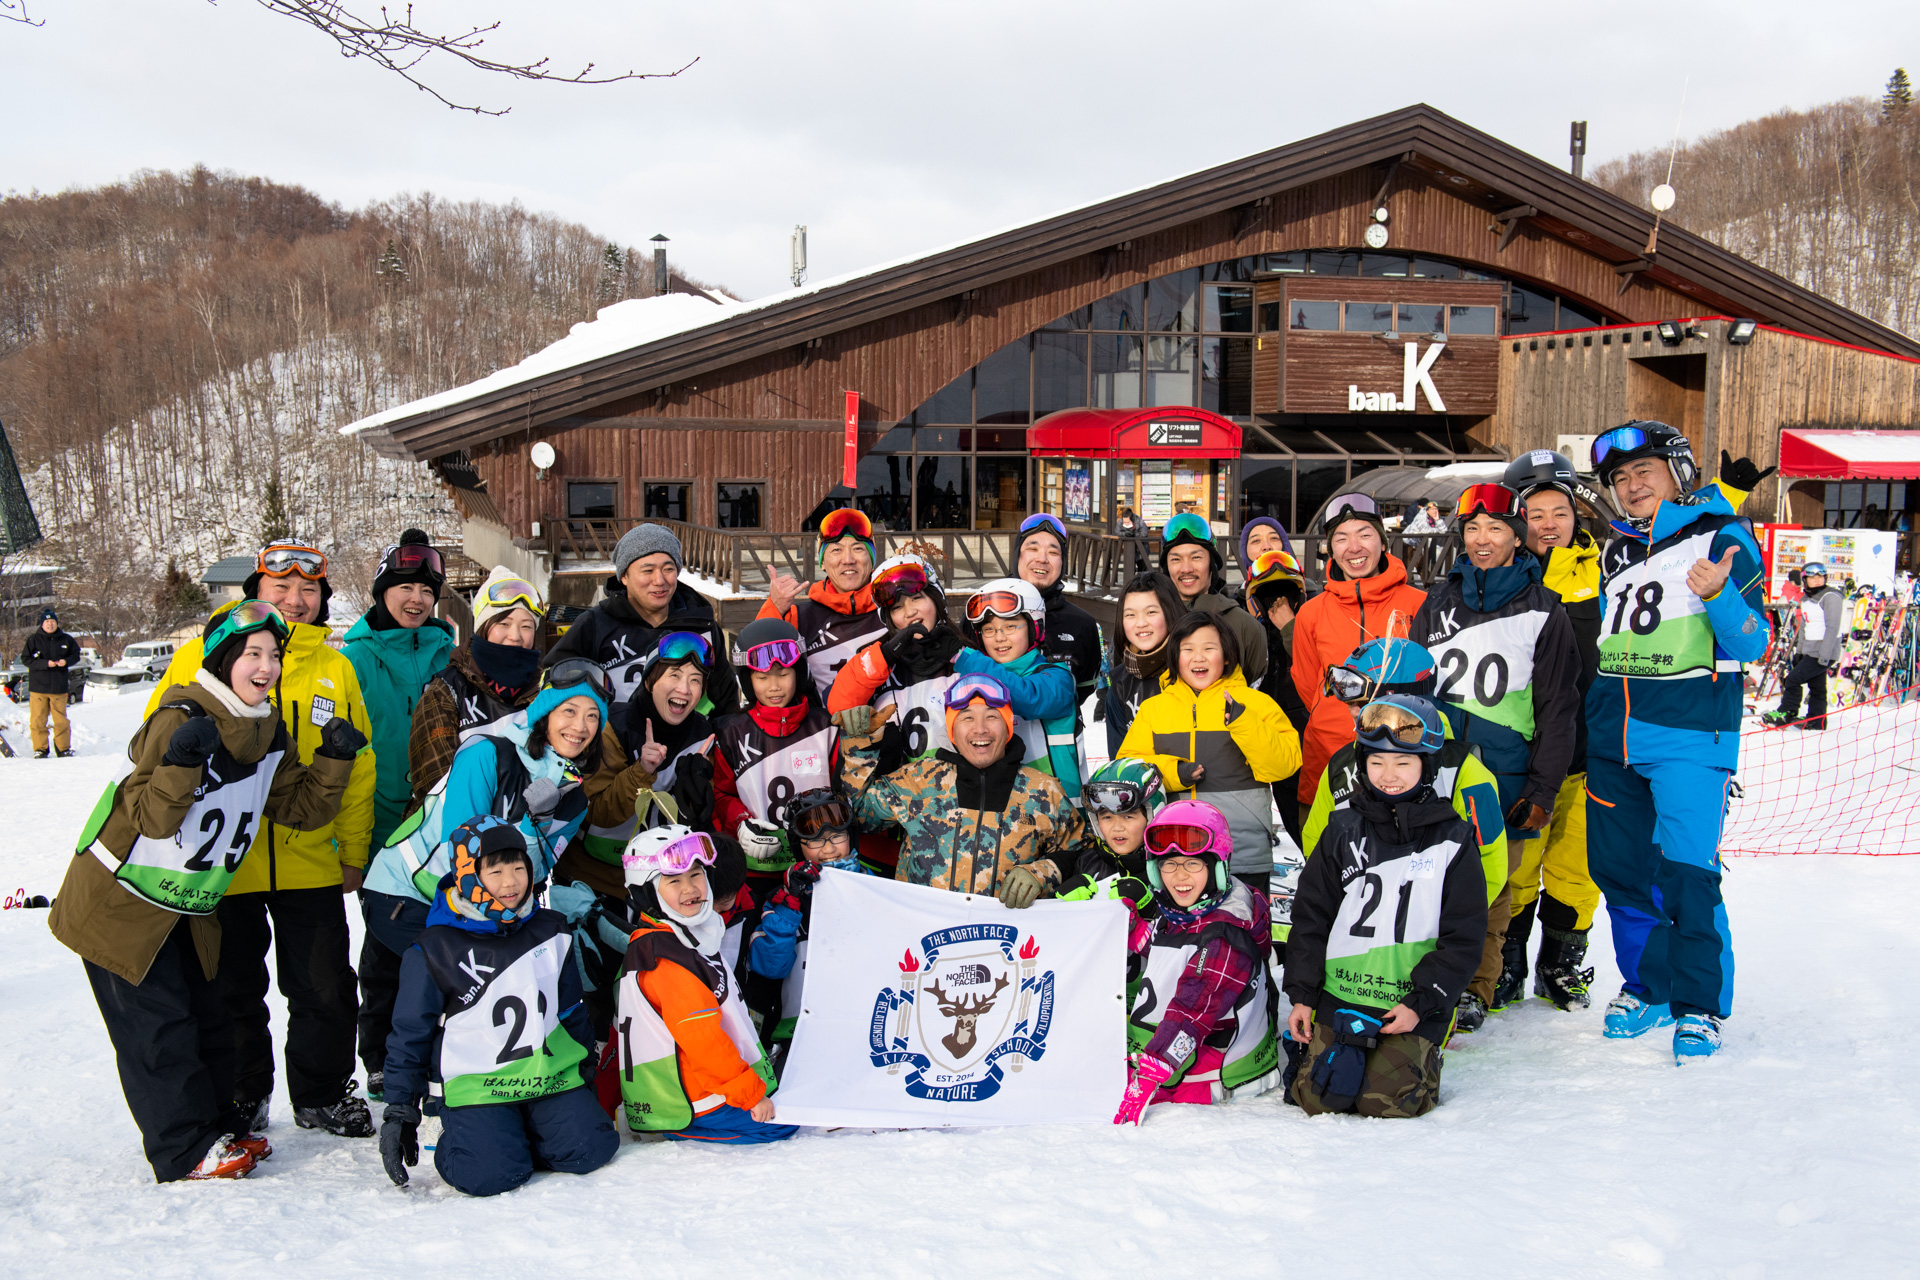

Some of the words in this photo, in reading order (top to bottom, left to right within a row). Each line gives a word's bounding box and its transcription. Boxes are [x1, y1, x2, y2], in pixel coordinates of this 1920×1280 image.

[1348, 342, 1447, 412] ban.K
[1573, 484, 1598, 503] DGE
[1610, 581, 1664, 636] 18
[1437, 648, 1509, 708] 20
[1615, 664, 1627, 673] SKI
[1628, 665, 1660, 675] SCHOOL
[313, 696, 335, 712] STAFF
[901, 706, 930, 759] 6
[767, 775, 796, 830] 8
[183, 807, 254, 874] 25
[1349, 872, 1413, 943] 21
[927, 934, 943, 948] THE
[948, 930, 980, 943] NORTH
[983, 926, 1011, 940] FACE
[959, 964, 976, 973] THE
[1195, 947, 1208, 975] DESCENTE
[458, 948, 496, 1005] ban.K
[946, 971, 976, 981] NORTH
[954, 978, 976, 987] FACE
[1356, 987, 1371, 998] SKI
[872, 1000, 887, 1048] RELATIONSHIP
[991, 1038, 1035, 1058] SCHOOL
[883, 1053, 918, 1065] KIDS
[936, 1074, 955, 1083] EST.
[955, 1072, 975, 1082] 2014
[491, 1089, 521, 1099] ban.K
[524, 1091, 540, 1099] SKI
[926, 1084, 978, 1100] NATURE
